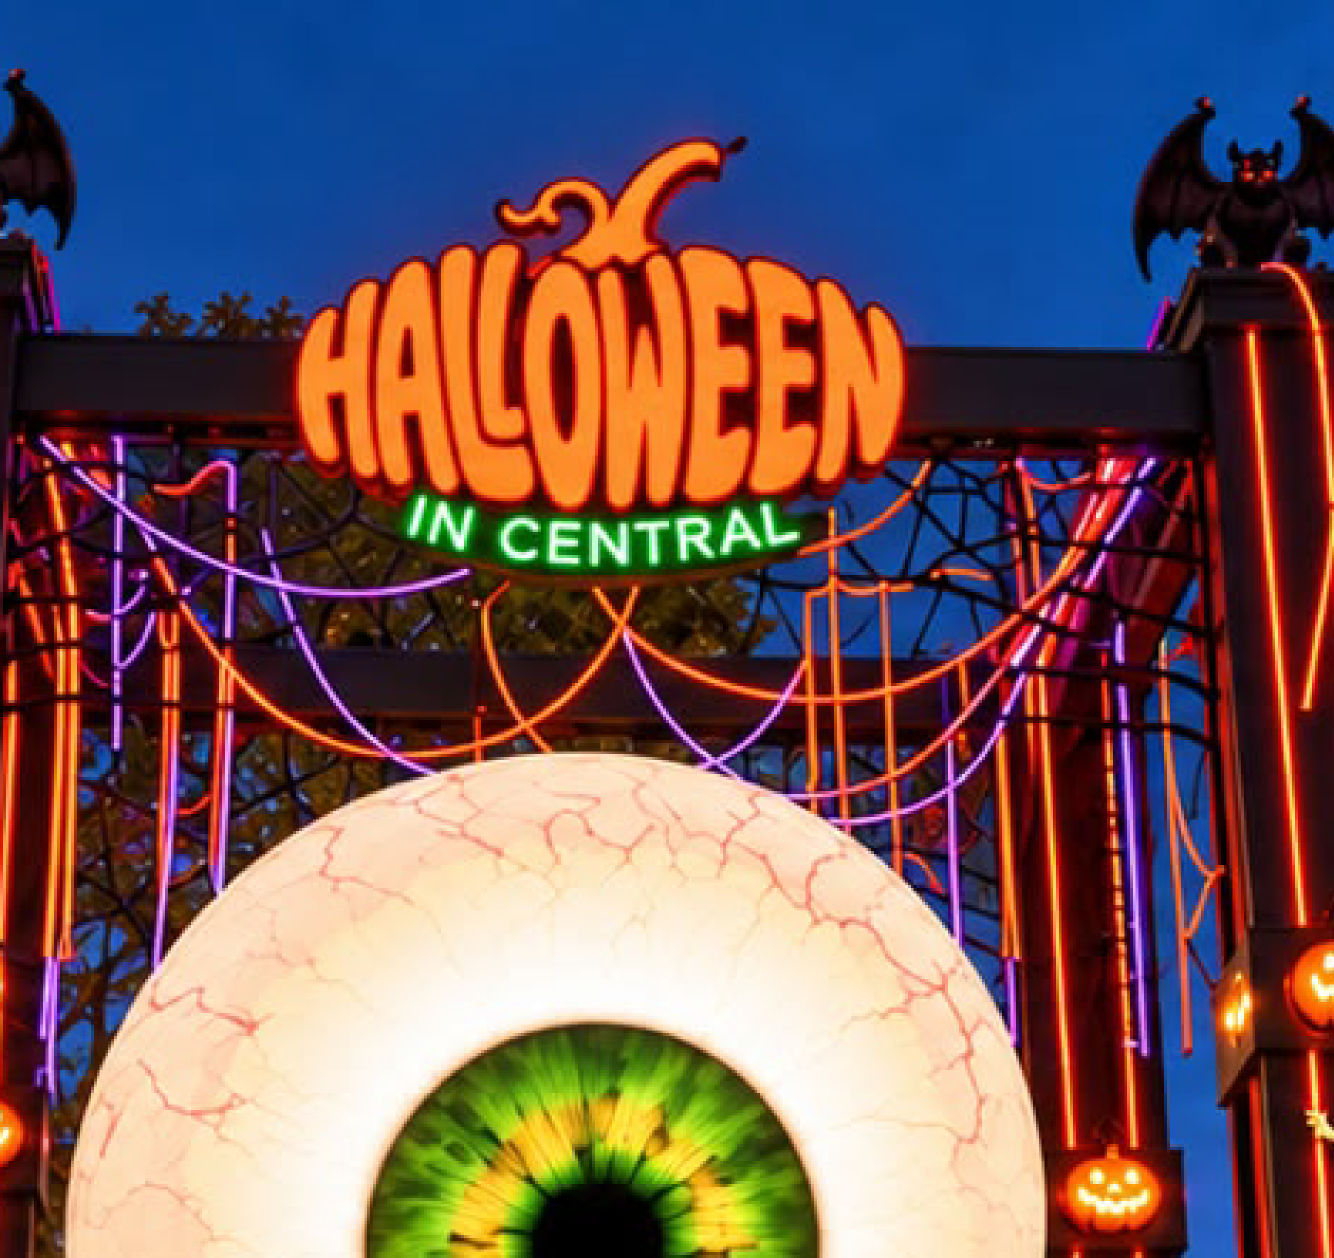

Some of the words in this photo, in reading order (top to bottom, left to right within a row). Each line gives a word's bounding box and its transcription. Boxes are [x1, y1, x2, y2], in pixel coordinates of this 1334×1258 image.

[298, 243, 905, 509] HALLOWEEN
[407, 494, 475, 551] IN
[498, 503, 800, 567] CENTRAL
